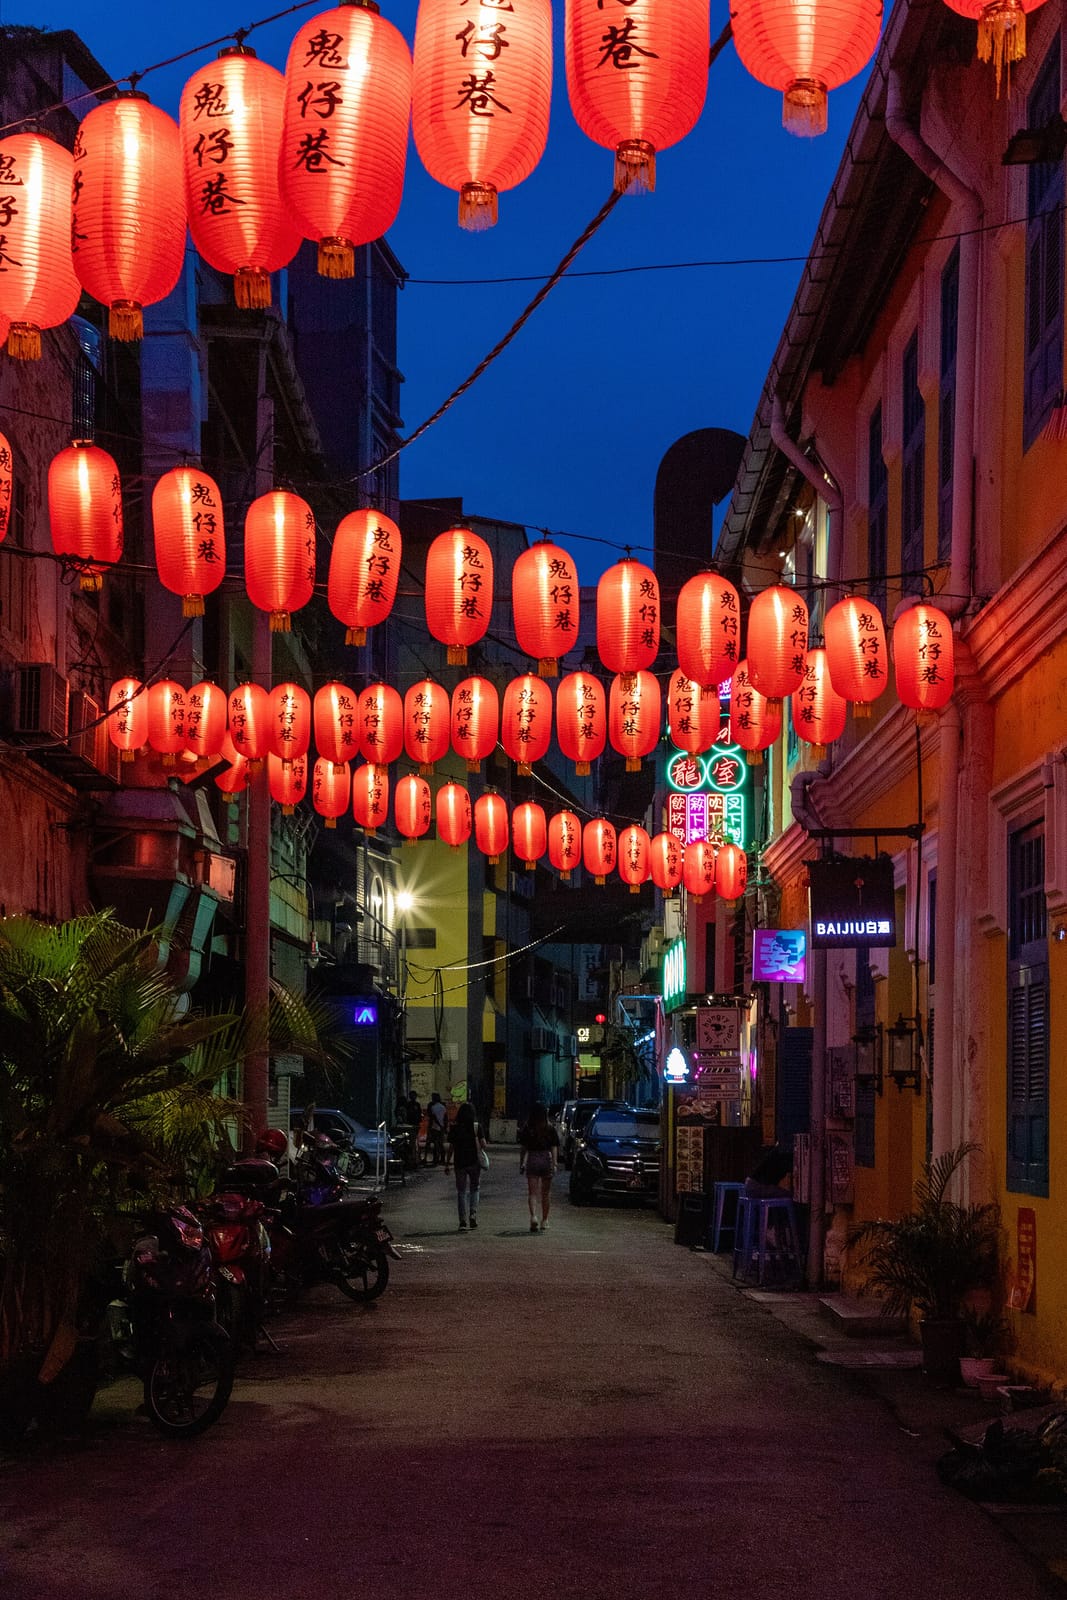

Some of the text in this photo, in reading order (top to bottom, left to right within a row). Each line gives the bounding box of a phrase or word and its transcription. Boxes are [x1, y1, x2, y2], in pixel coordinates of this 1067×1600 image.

[293, 28, 350, 174] 鬼仔巷
[192, 82, 246, 216] 鬼仔巷
[192, 482, 221, 564] 鬼仔巷
[363, 526, 393, 603] 鬼仔巷
[459, 545, 484, 620] 鬼仔巷
[549, 559, 576, 631] 鬼仔巷
[639, 578, 658, 649] 鬼仔巷
[720, 590, 738, 663] 鬼仔巷
[790, 605, 808, 675] 鬼仔巷
[858, 613, 885, 679] 鬼仔巷
[918, 619, 945, 685] 鬼仔巷
[170, 691, 186, 737] 鬼仔巷
[186, 694, 205, 741] 鬼仔巷
[231, 697, 252, 745] 鬼仔巷
[277, 694, 298, 742] 鬼仔巷
[337, 694, 357, 746] 鬼仔巷
[363, 695, 384, 746] 鬼仔巷
[413, 692, 433, 745] 鬼仔巷
[456, 689, 477, 741] 鬼仔巷
[516, 689, 538, 743] 鬼仔巷
[577, 684, 599, 740] 鬼仔巷
[674, 676, 699, 734] 鬼仔巷
[735, 670, 760, 730] 鬼仔巷
[712, 757, 739, 786] 室
[816, 922, 865, 935] BAIJIU
[703, 1015, 730, 1027] hungry
